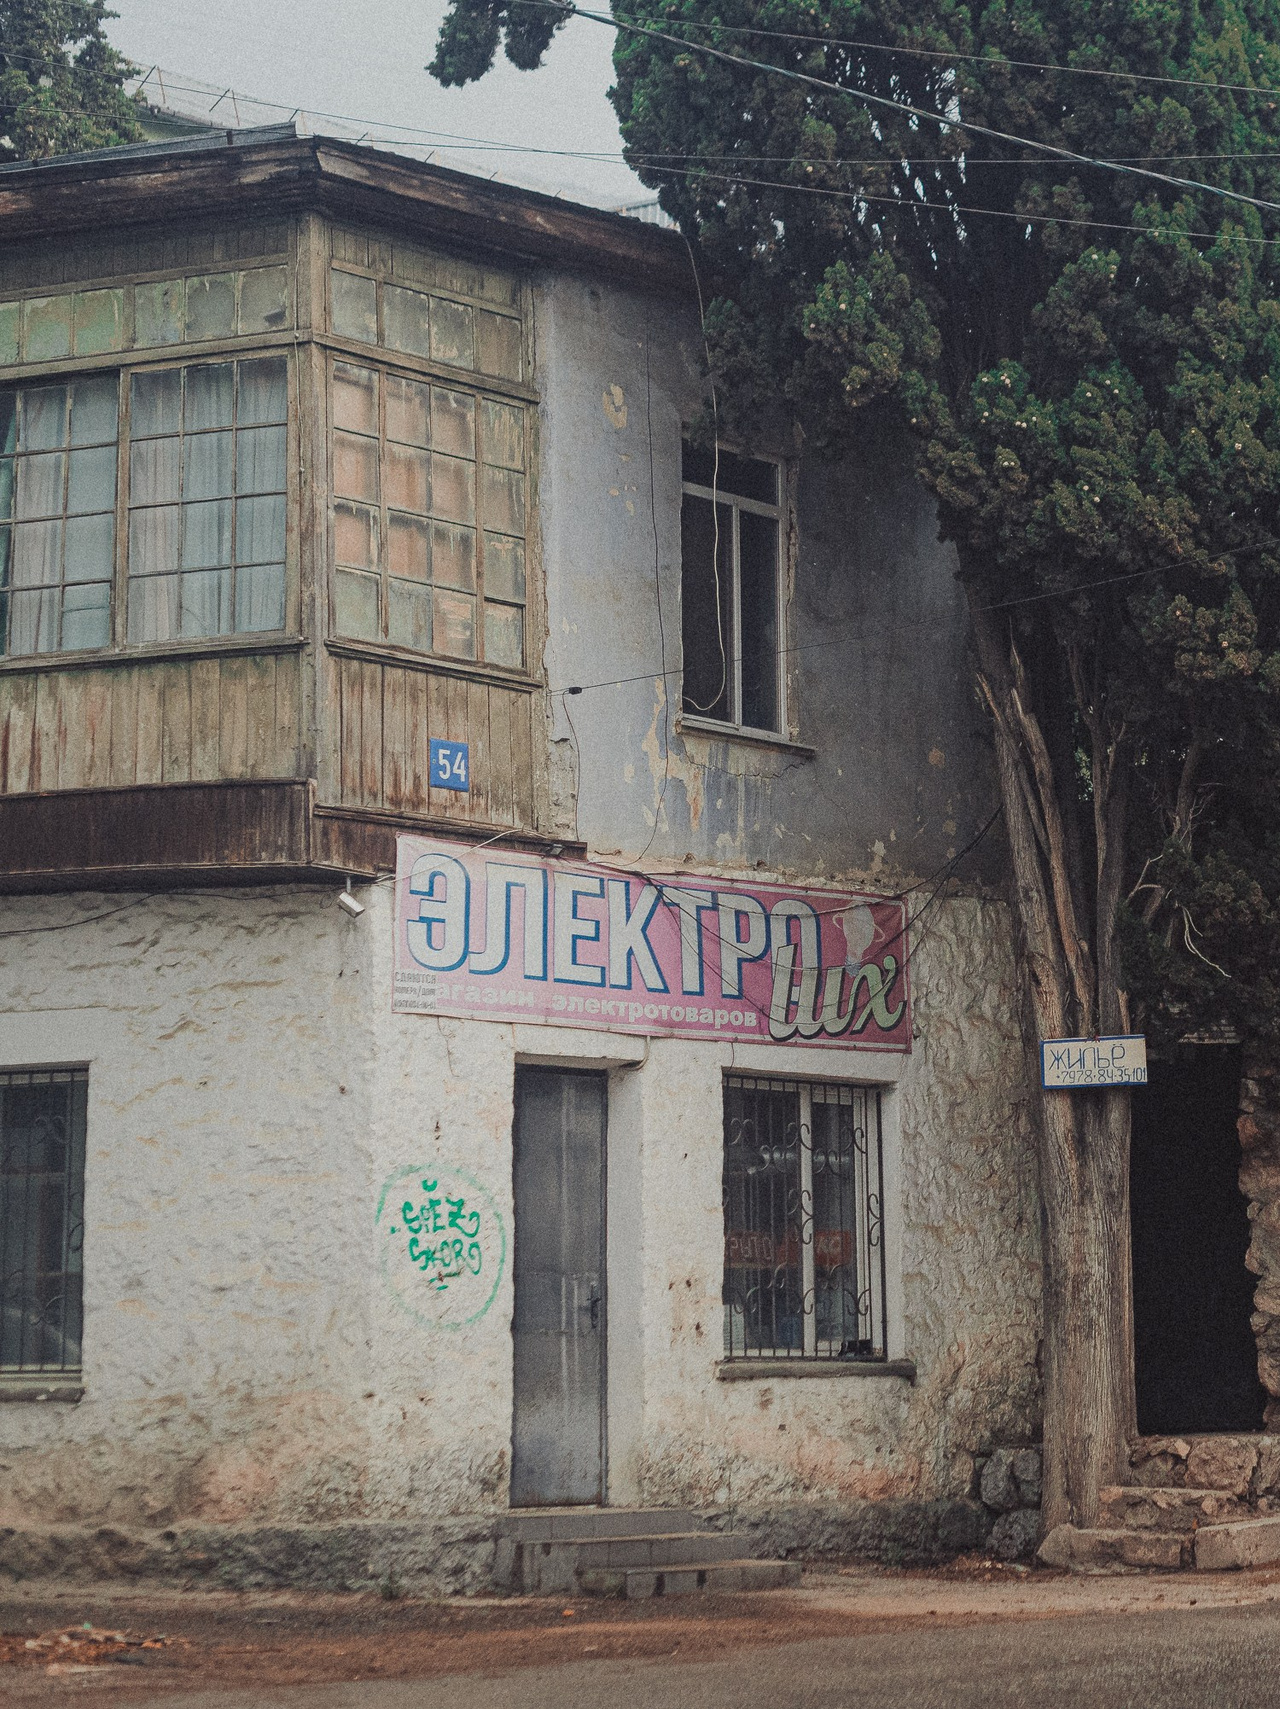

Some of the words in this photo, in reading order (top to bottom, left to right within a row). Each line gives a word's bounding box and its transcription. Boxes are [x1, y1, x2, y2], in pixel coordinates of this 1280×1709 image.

[438, 748, 466, 783] 54
[406, 852, 822, 1004] ЭЛЕКТРО
[437, 983, 535, 1008] агазин
[552, 993, 757, 1029] электротоваров
[1049, 1043, 1126, 1070] ЖИЛЬЁ
